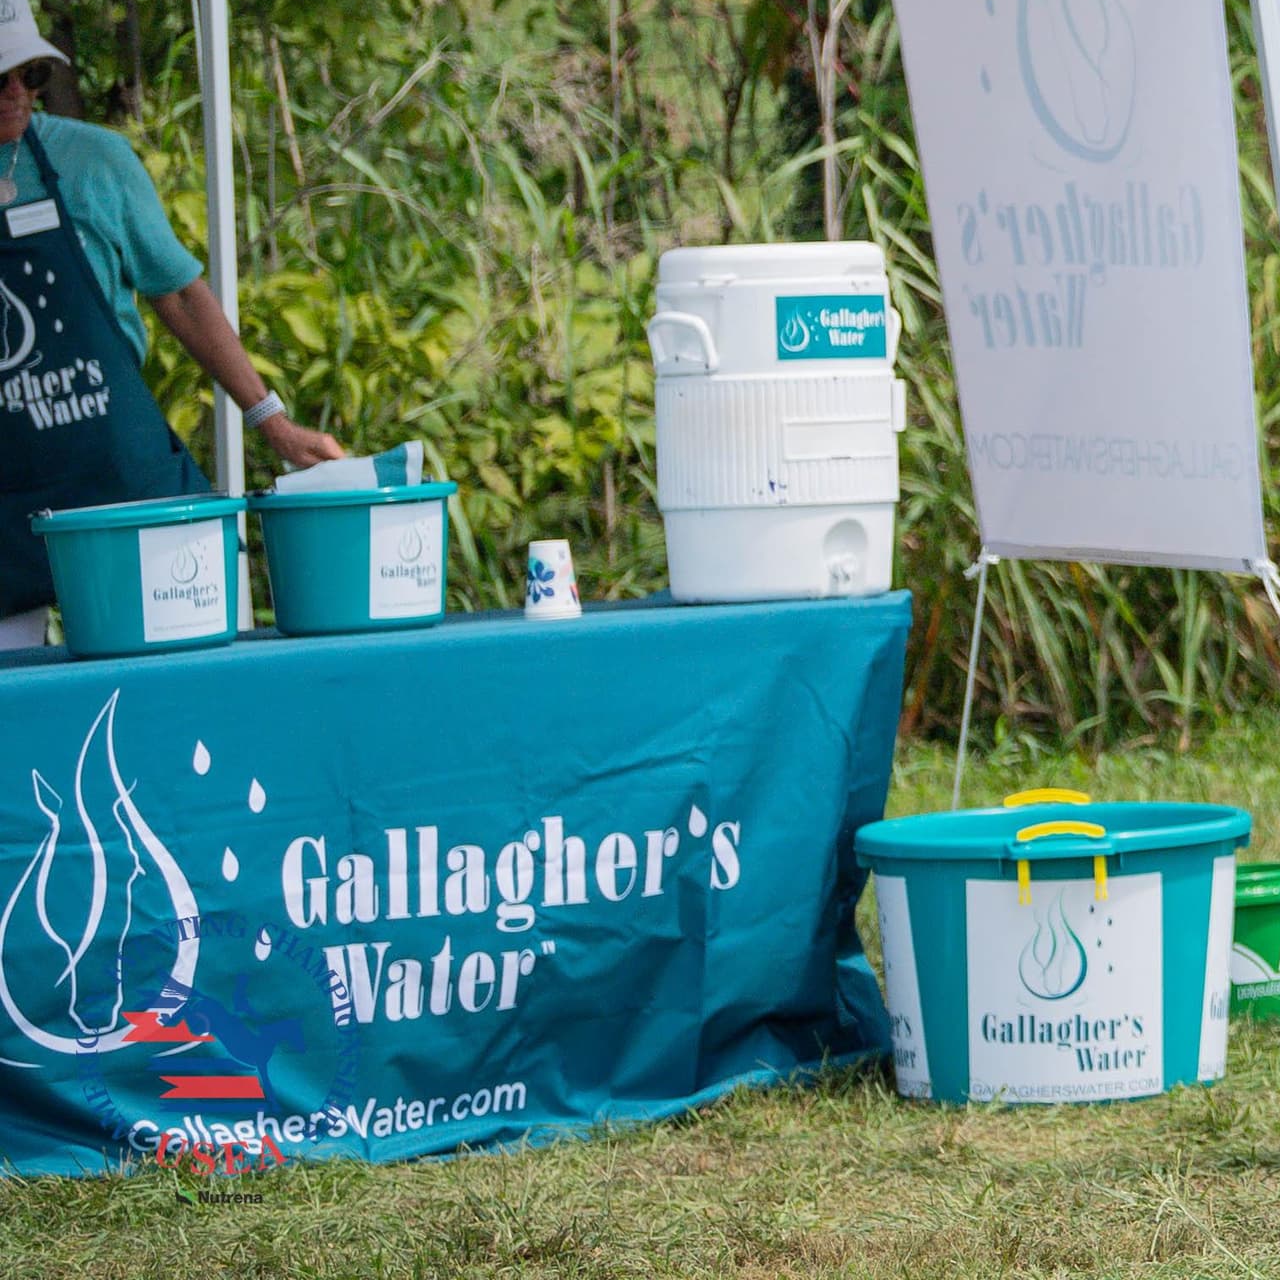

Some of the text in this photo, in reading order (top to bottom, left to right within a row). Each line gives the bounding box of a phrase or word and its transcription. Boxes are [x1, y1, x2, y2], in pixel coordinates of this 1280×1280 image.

[0, 357, 104, 413] gher's
[26, 388, 110, 431] Water
[281, 804, 741, 933] Gallagher's
[981, 1012, 1144, 1052] Gallagher's
[1075, 1046, 1147, 1073] Water
